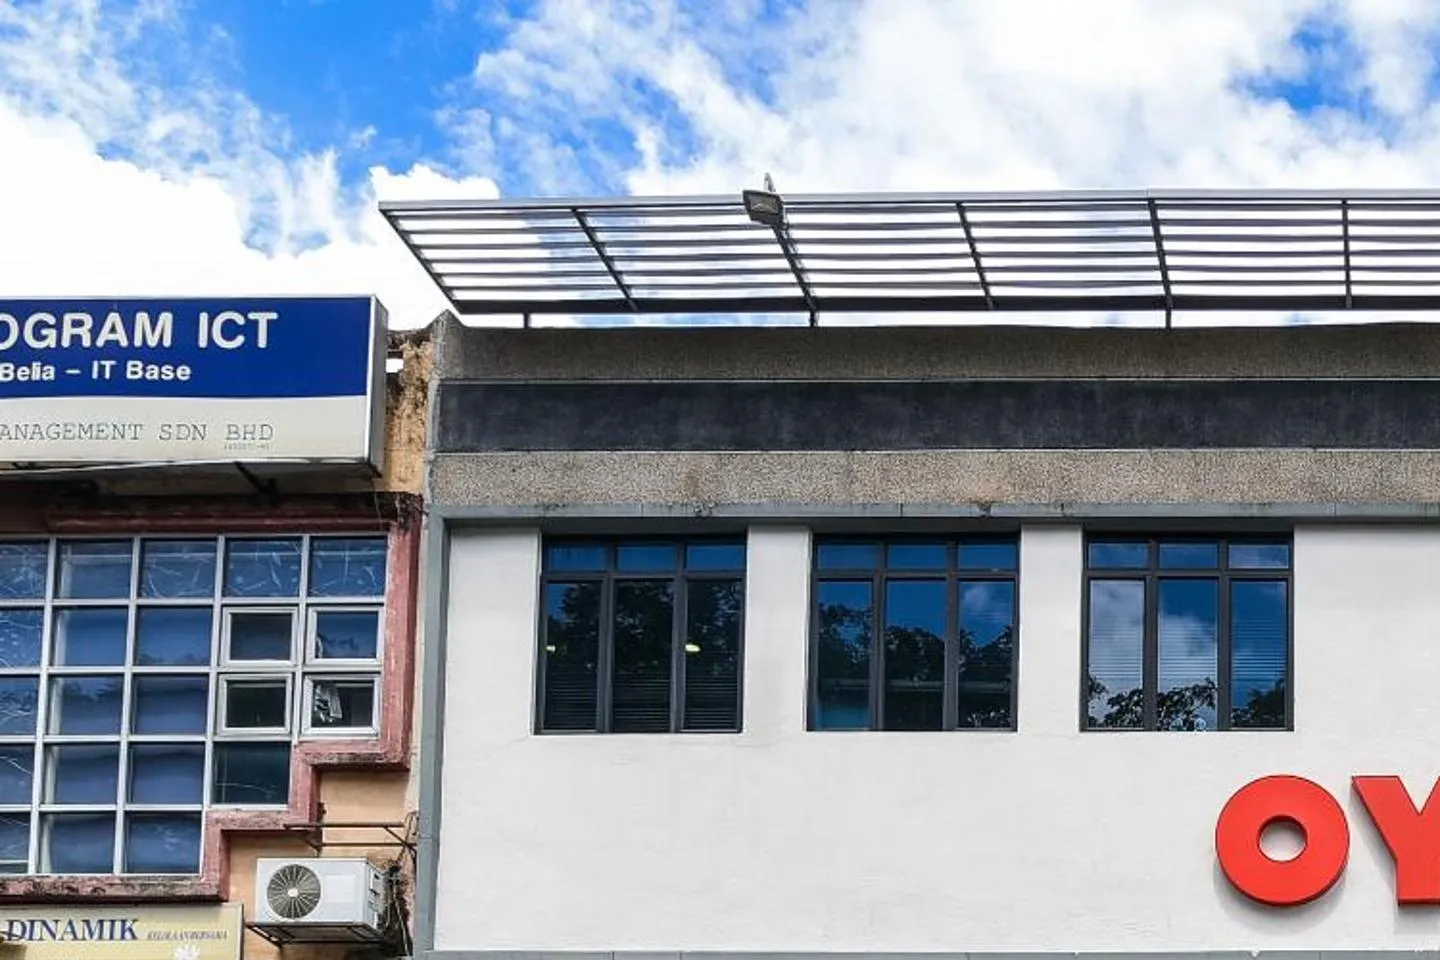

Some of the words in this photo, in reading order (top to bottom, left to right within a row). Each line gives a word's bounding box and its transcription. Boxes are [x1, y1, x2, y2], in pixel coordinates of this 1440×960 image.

[199, 311, 278, 349] ICT
[92, 361, 116, 380] IT
[126, 361, 191, 381] Base
[159, 423, 206, 441] SDN
[226, 423, 274, 441] BHD
[7, 919, 138, 941] DINAMIK
